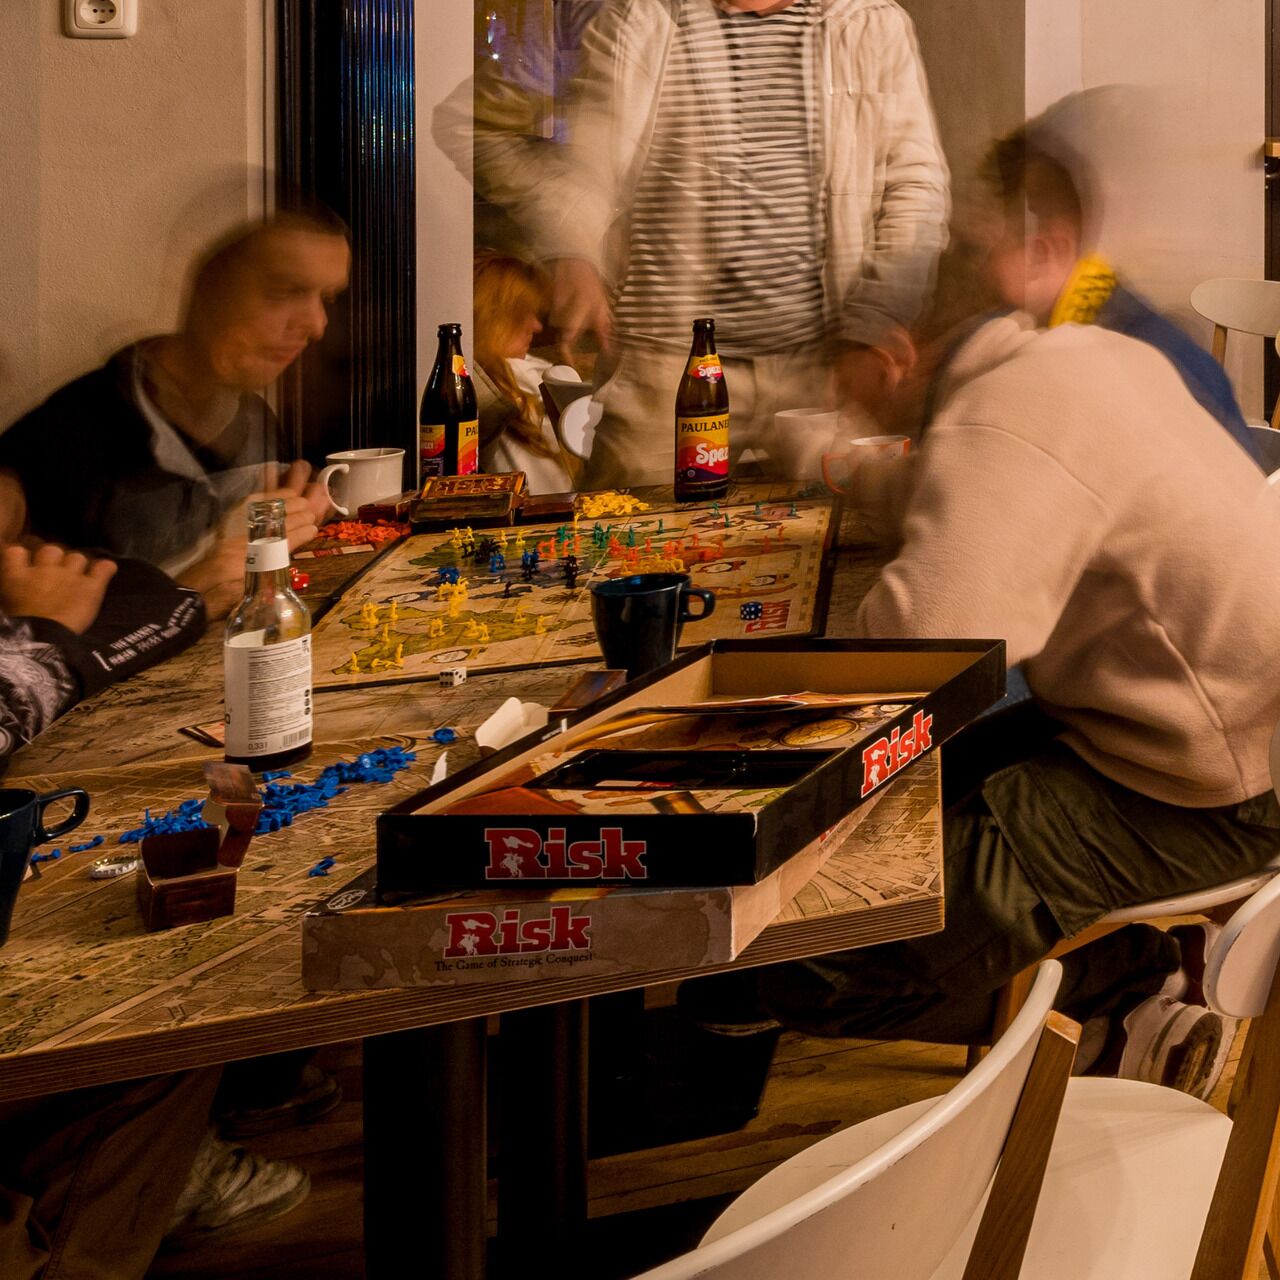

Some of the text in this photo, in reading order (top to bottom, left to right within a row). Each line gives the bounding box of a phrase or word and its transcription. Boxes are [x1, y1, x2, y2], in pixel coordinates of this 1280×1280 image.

[681, 420, 729, 432] PAULANE
[861, 709, 933, 799] Risk
[484, 827, 648, 879] Risk
[443, 906, 592, 959] Risk
[434, 951, 593, 973] The Game of Strategic Conquest
